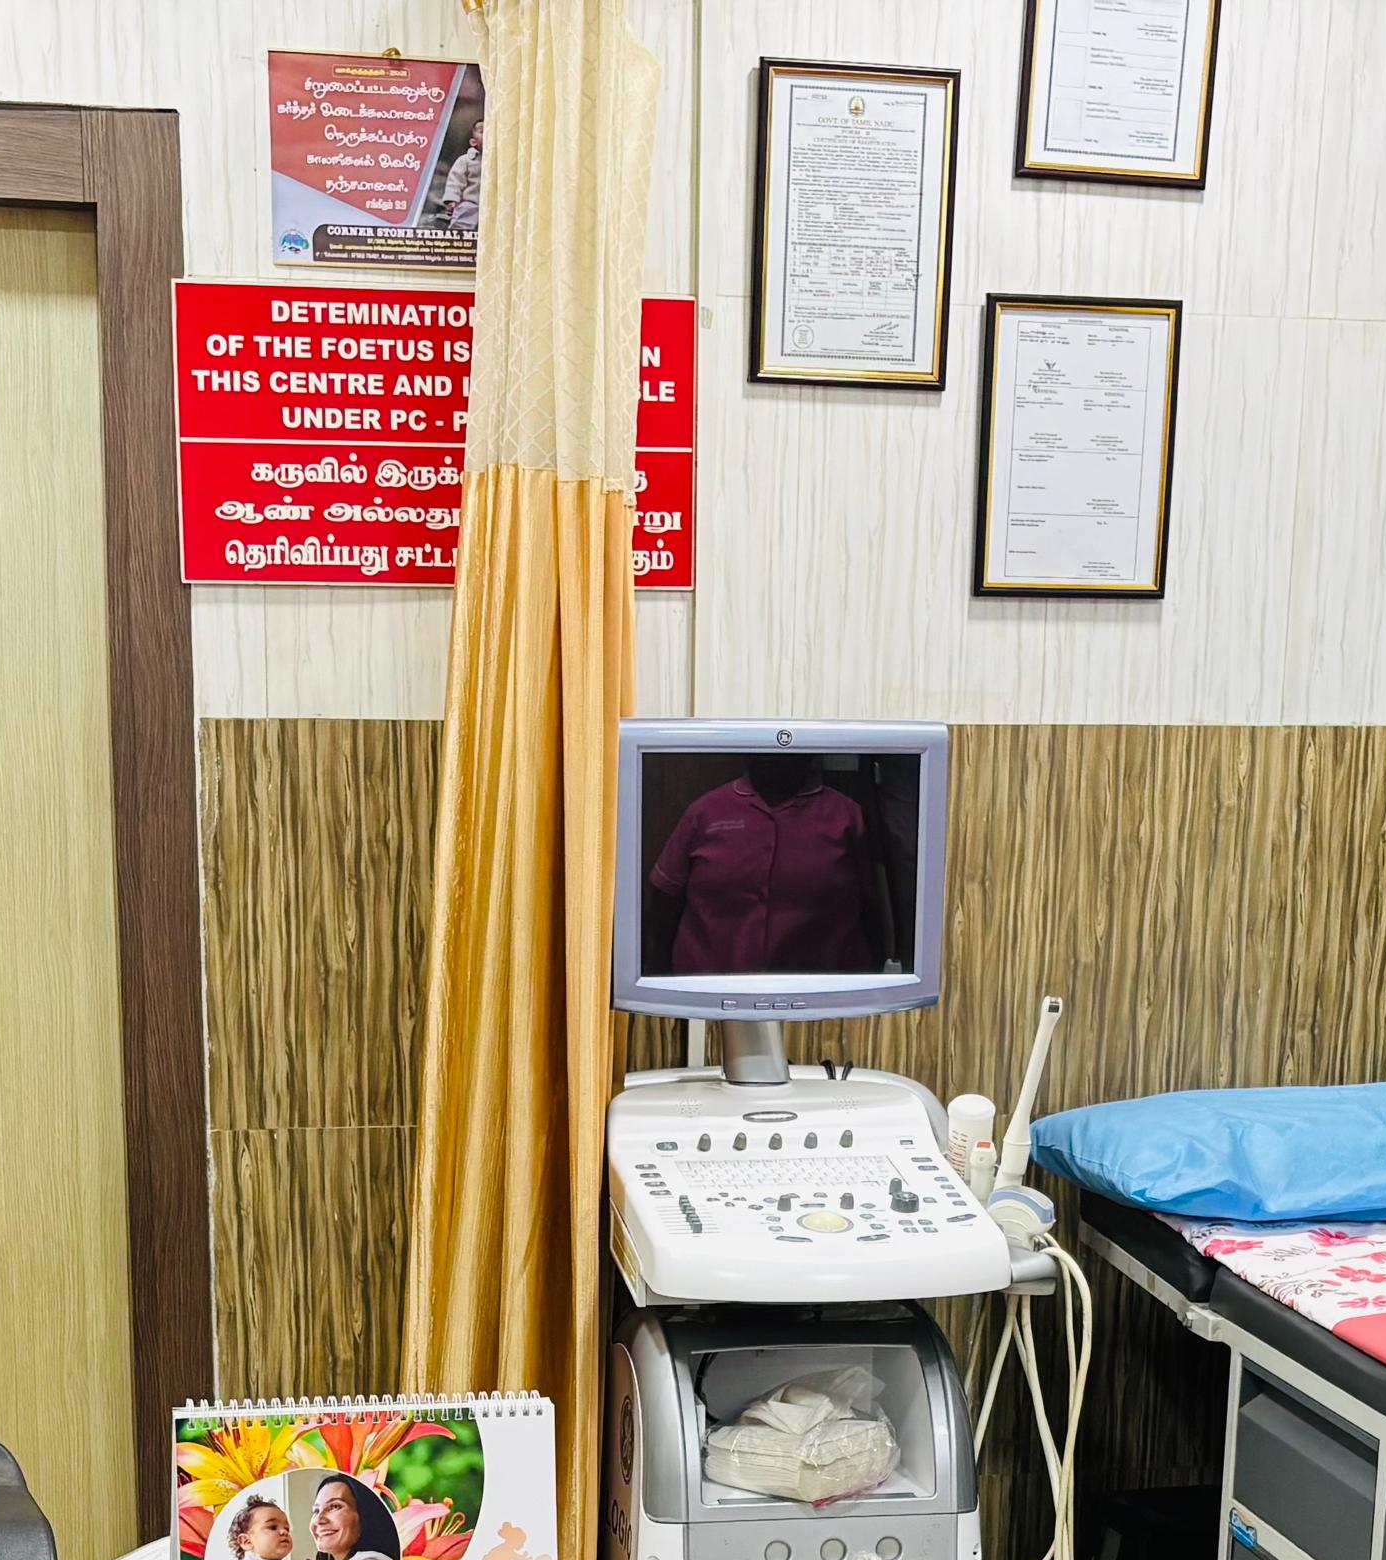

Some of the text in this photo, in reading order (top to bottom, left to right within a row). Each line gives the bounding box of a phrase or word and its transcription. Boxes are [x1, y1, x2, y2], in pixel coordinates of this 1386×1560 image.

[277, 100, 316, 120] கர்த்தர்
[327, 225, 478, 240] CORNER STONE TRIBAL MI
[271, 300, 475, 327] DETEMINATIO
[206, 334, 661, 368] OF THE FOETUS IS N
[192, 369, 260, 392] THIS
[269, 371, 384, 396] CENTRE
[393, 375, 452, 397] AND
[637, 381, 675, 402] LE
[282, 407, 381, 431] UNDER
[390, 410, 426, 431] PC
[453, 411, 469, 432] P
[251, 452, 464, 490] கருவில் இருக்
[215, 495, 314, 524] ஆண்
[225, 533, 389, 575] தெரிவிப்பது
[395, 543, 457, 568] சட்ட
